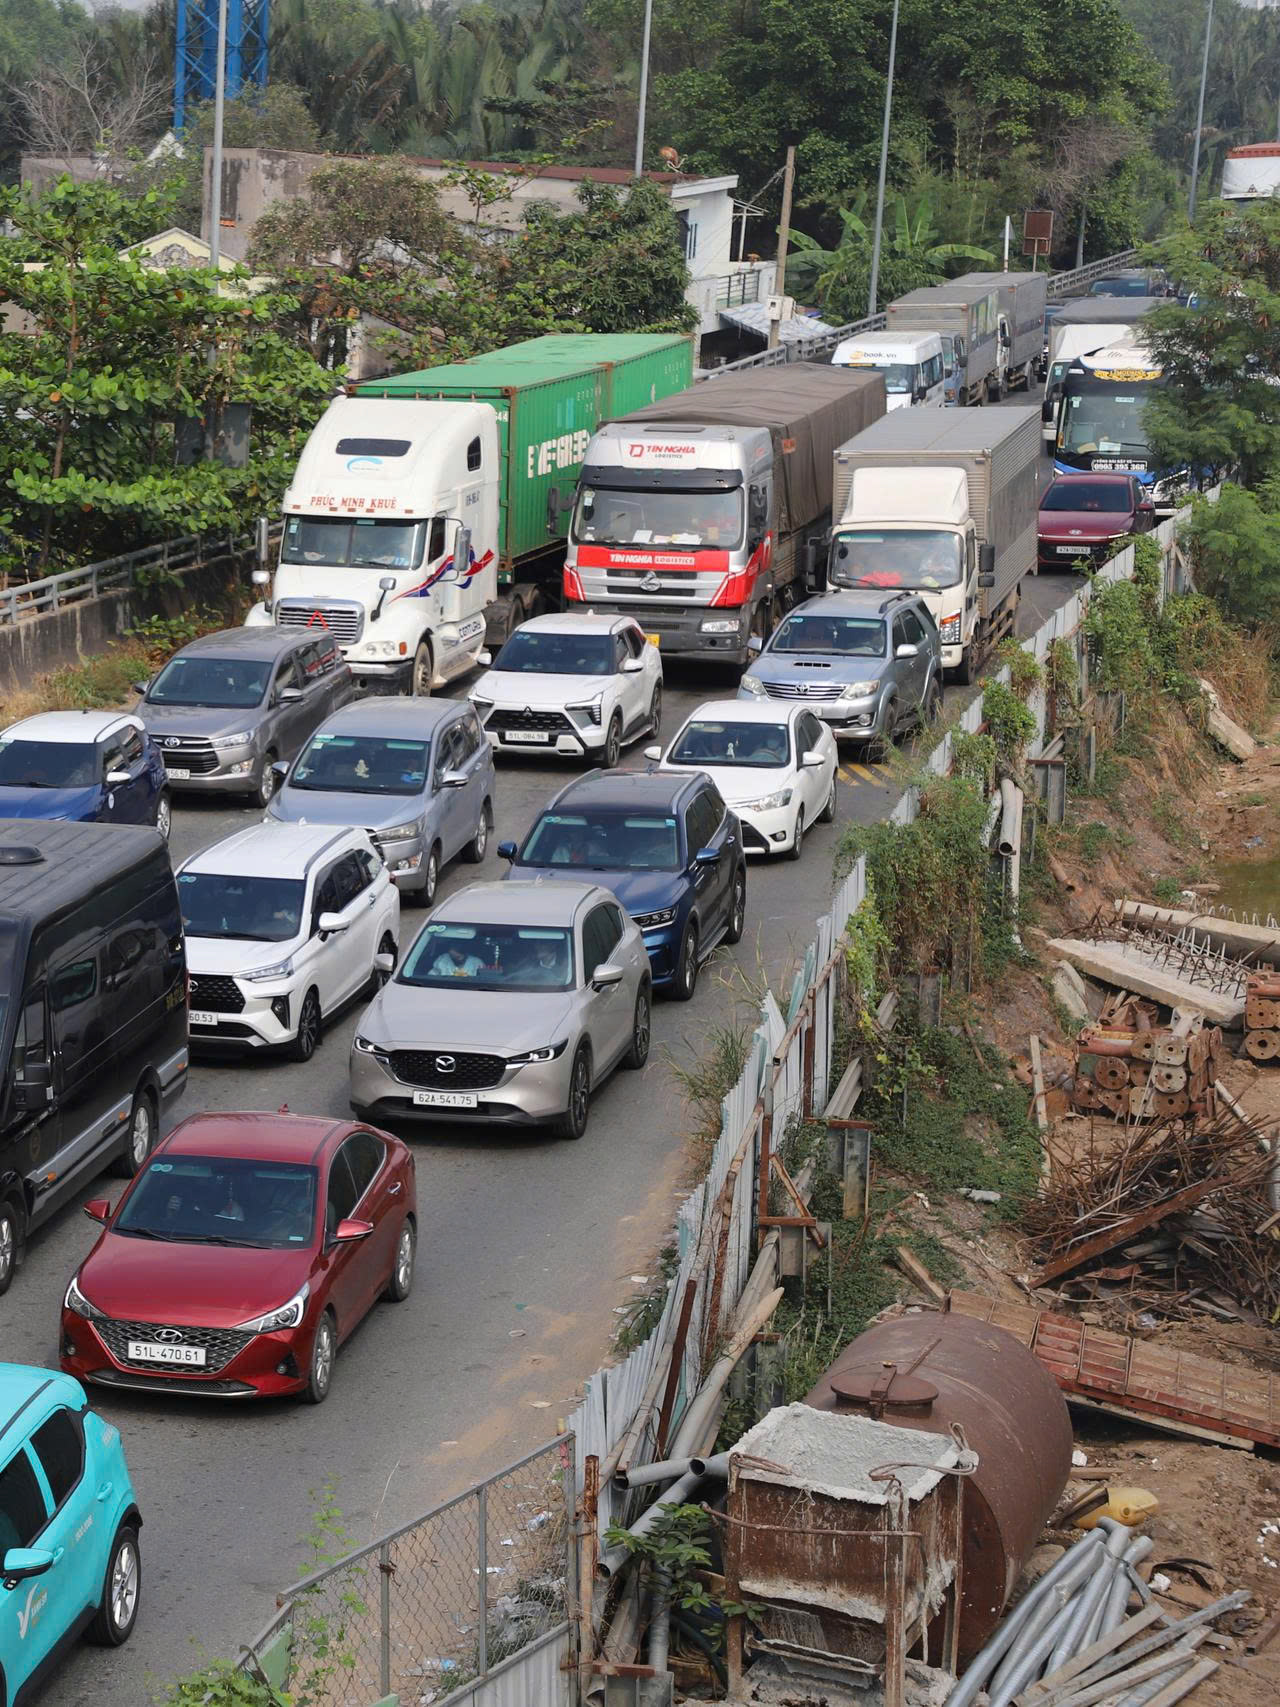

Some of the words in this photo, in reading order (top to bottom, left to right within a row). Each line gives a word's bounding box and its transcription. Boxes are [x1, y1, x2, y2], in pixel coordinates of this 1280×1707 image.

[340, 496, 366, 508] MINH
[656, 556, 694, 564] LOGISTICS
[418, 1093, 472, 1105] 62A-541.75
[134, 1345, 199, 1361] 51L-470.61
